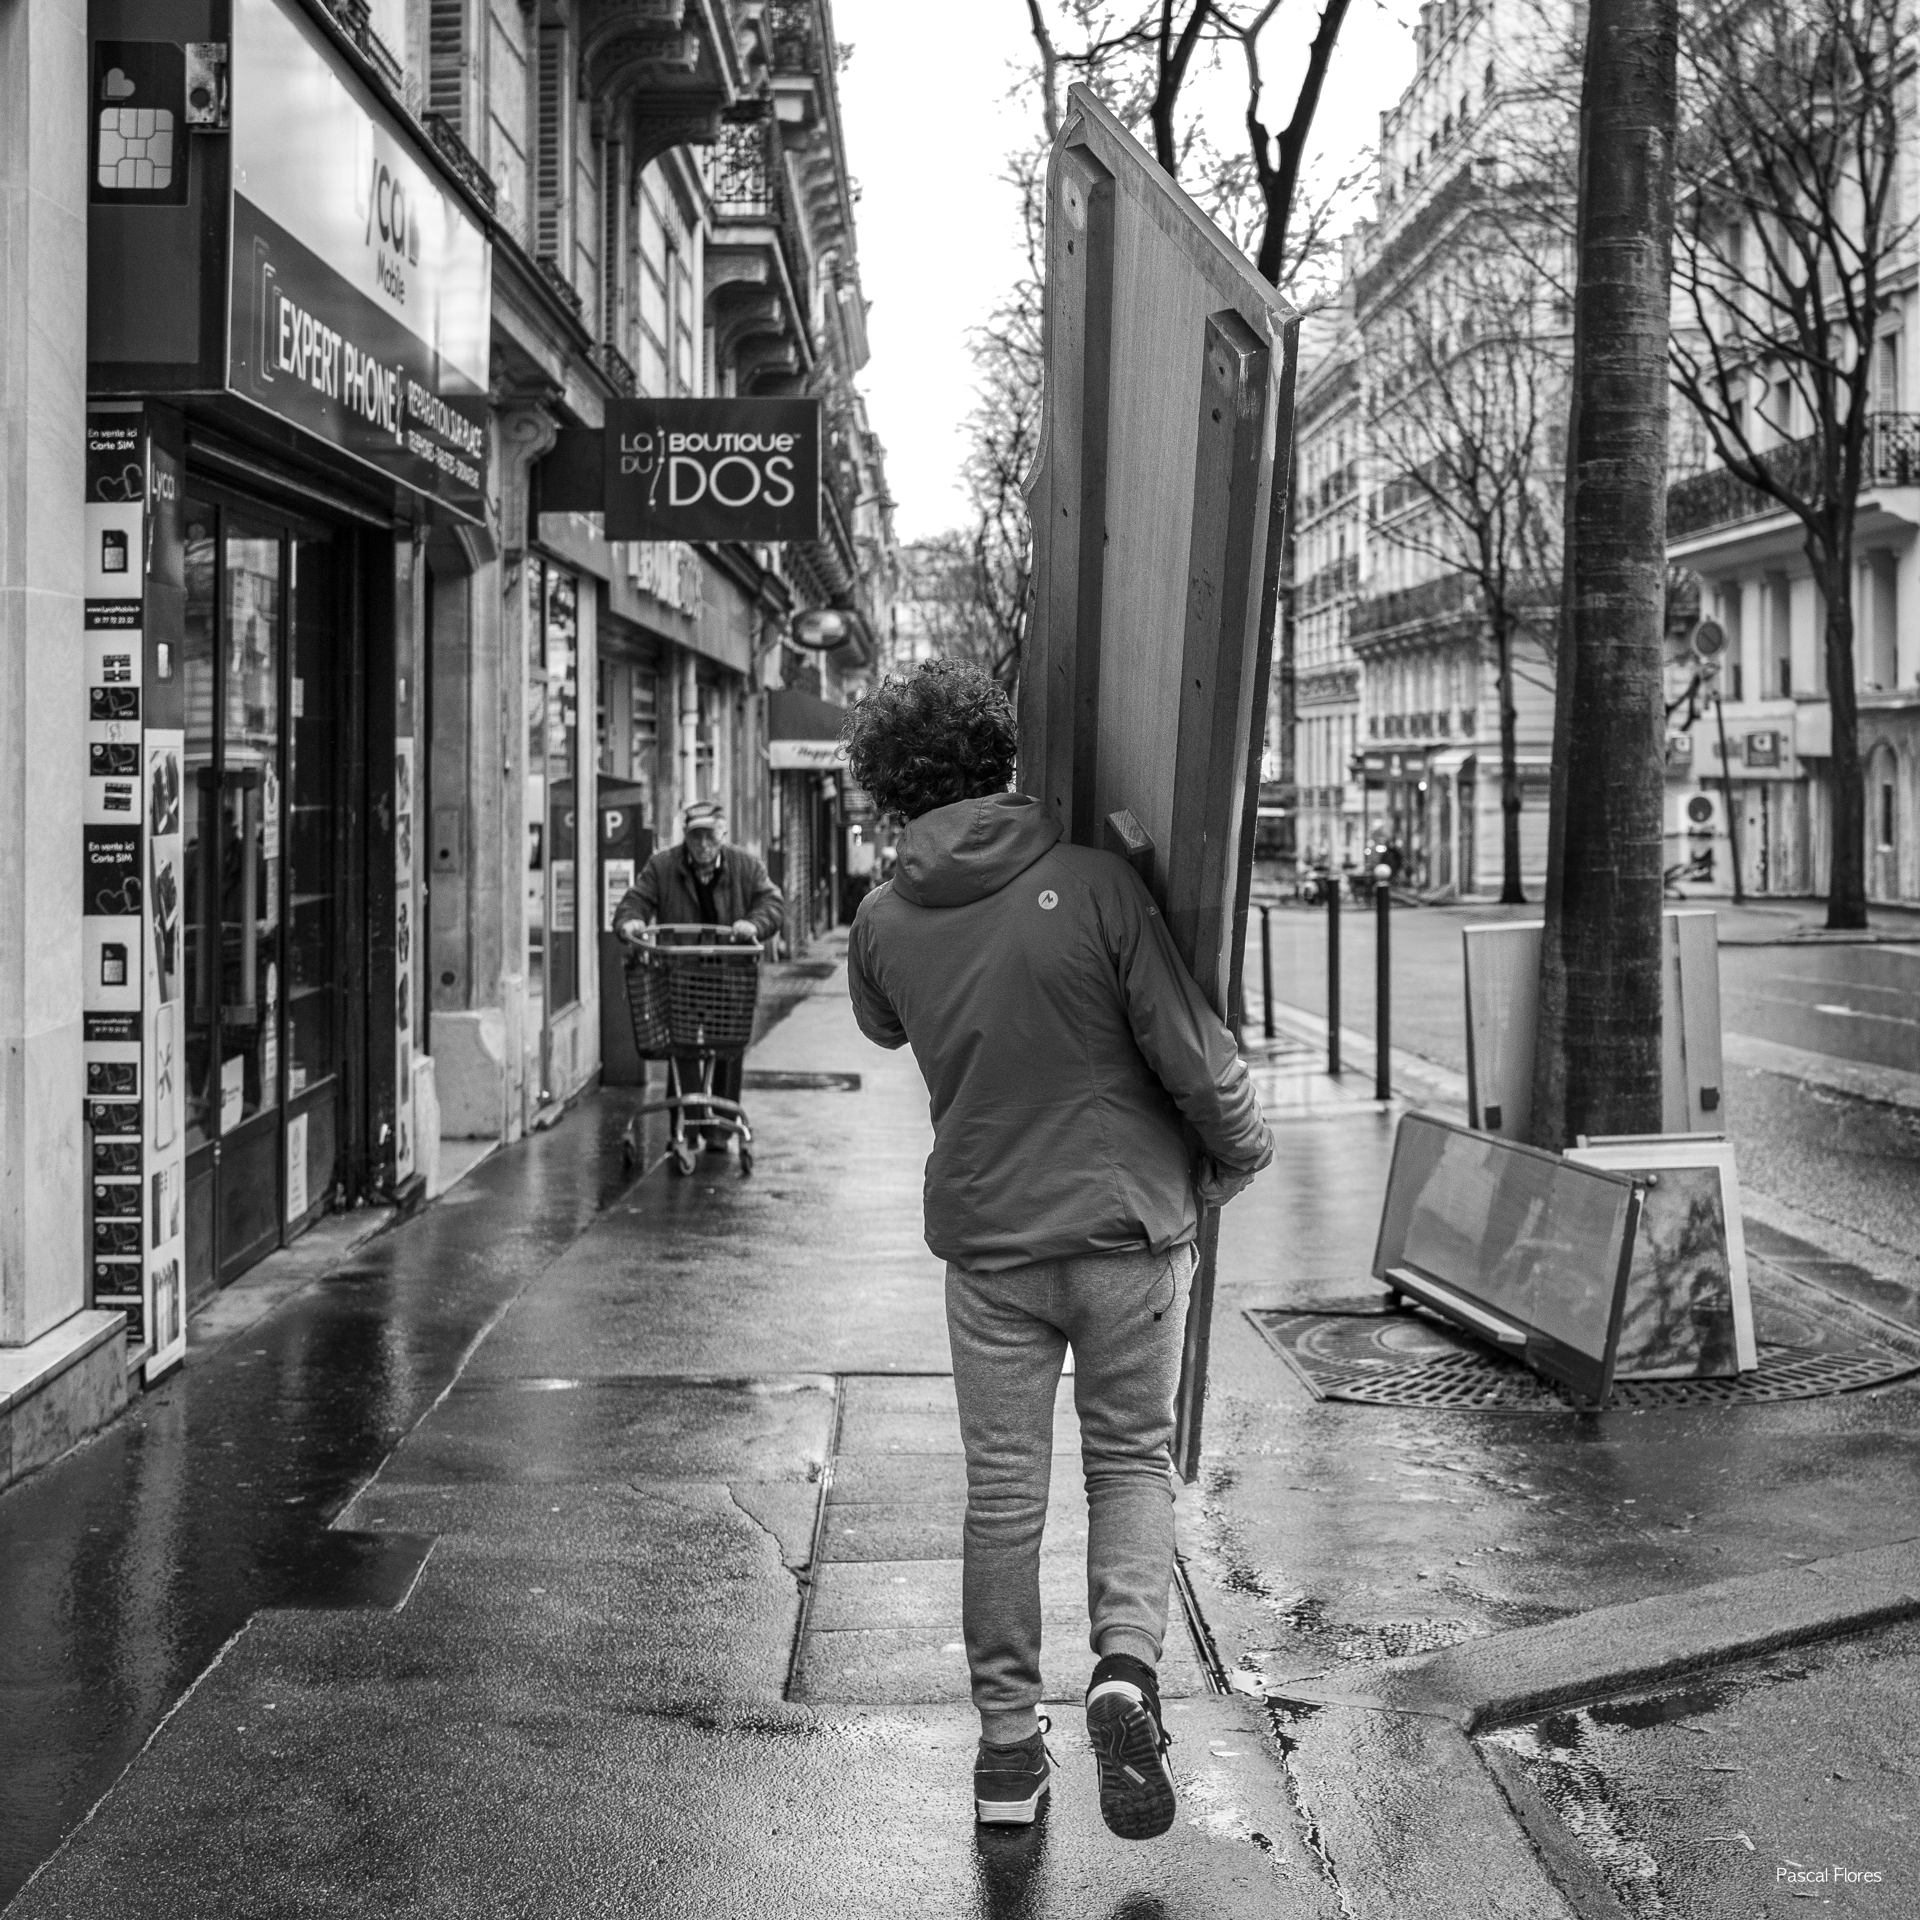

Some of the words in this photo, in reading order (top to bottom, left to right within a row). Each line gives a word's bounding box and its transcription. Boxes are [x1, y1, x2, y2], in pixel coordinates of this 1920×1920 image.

[376, 250, 405, 305] Mobile
[280, 296, 342, 399] EXPERT
[344, 341, 397, 433] PHONE
[88, 428, 99, 438] En
[152, 462, 175, 502] Lyca
[620, 456, 653, 474] DU
[669, 455, 795, 507] DOS
[605, 810, 623, 839] P
[88, 841, 100, 852] En
